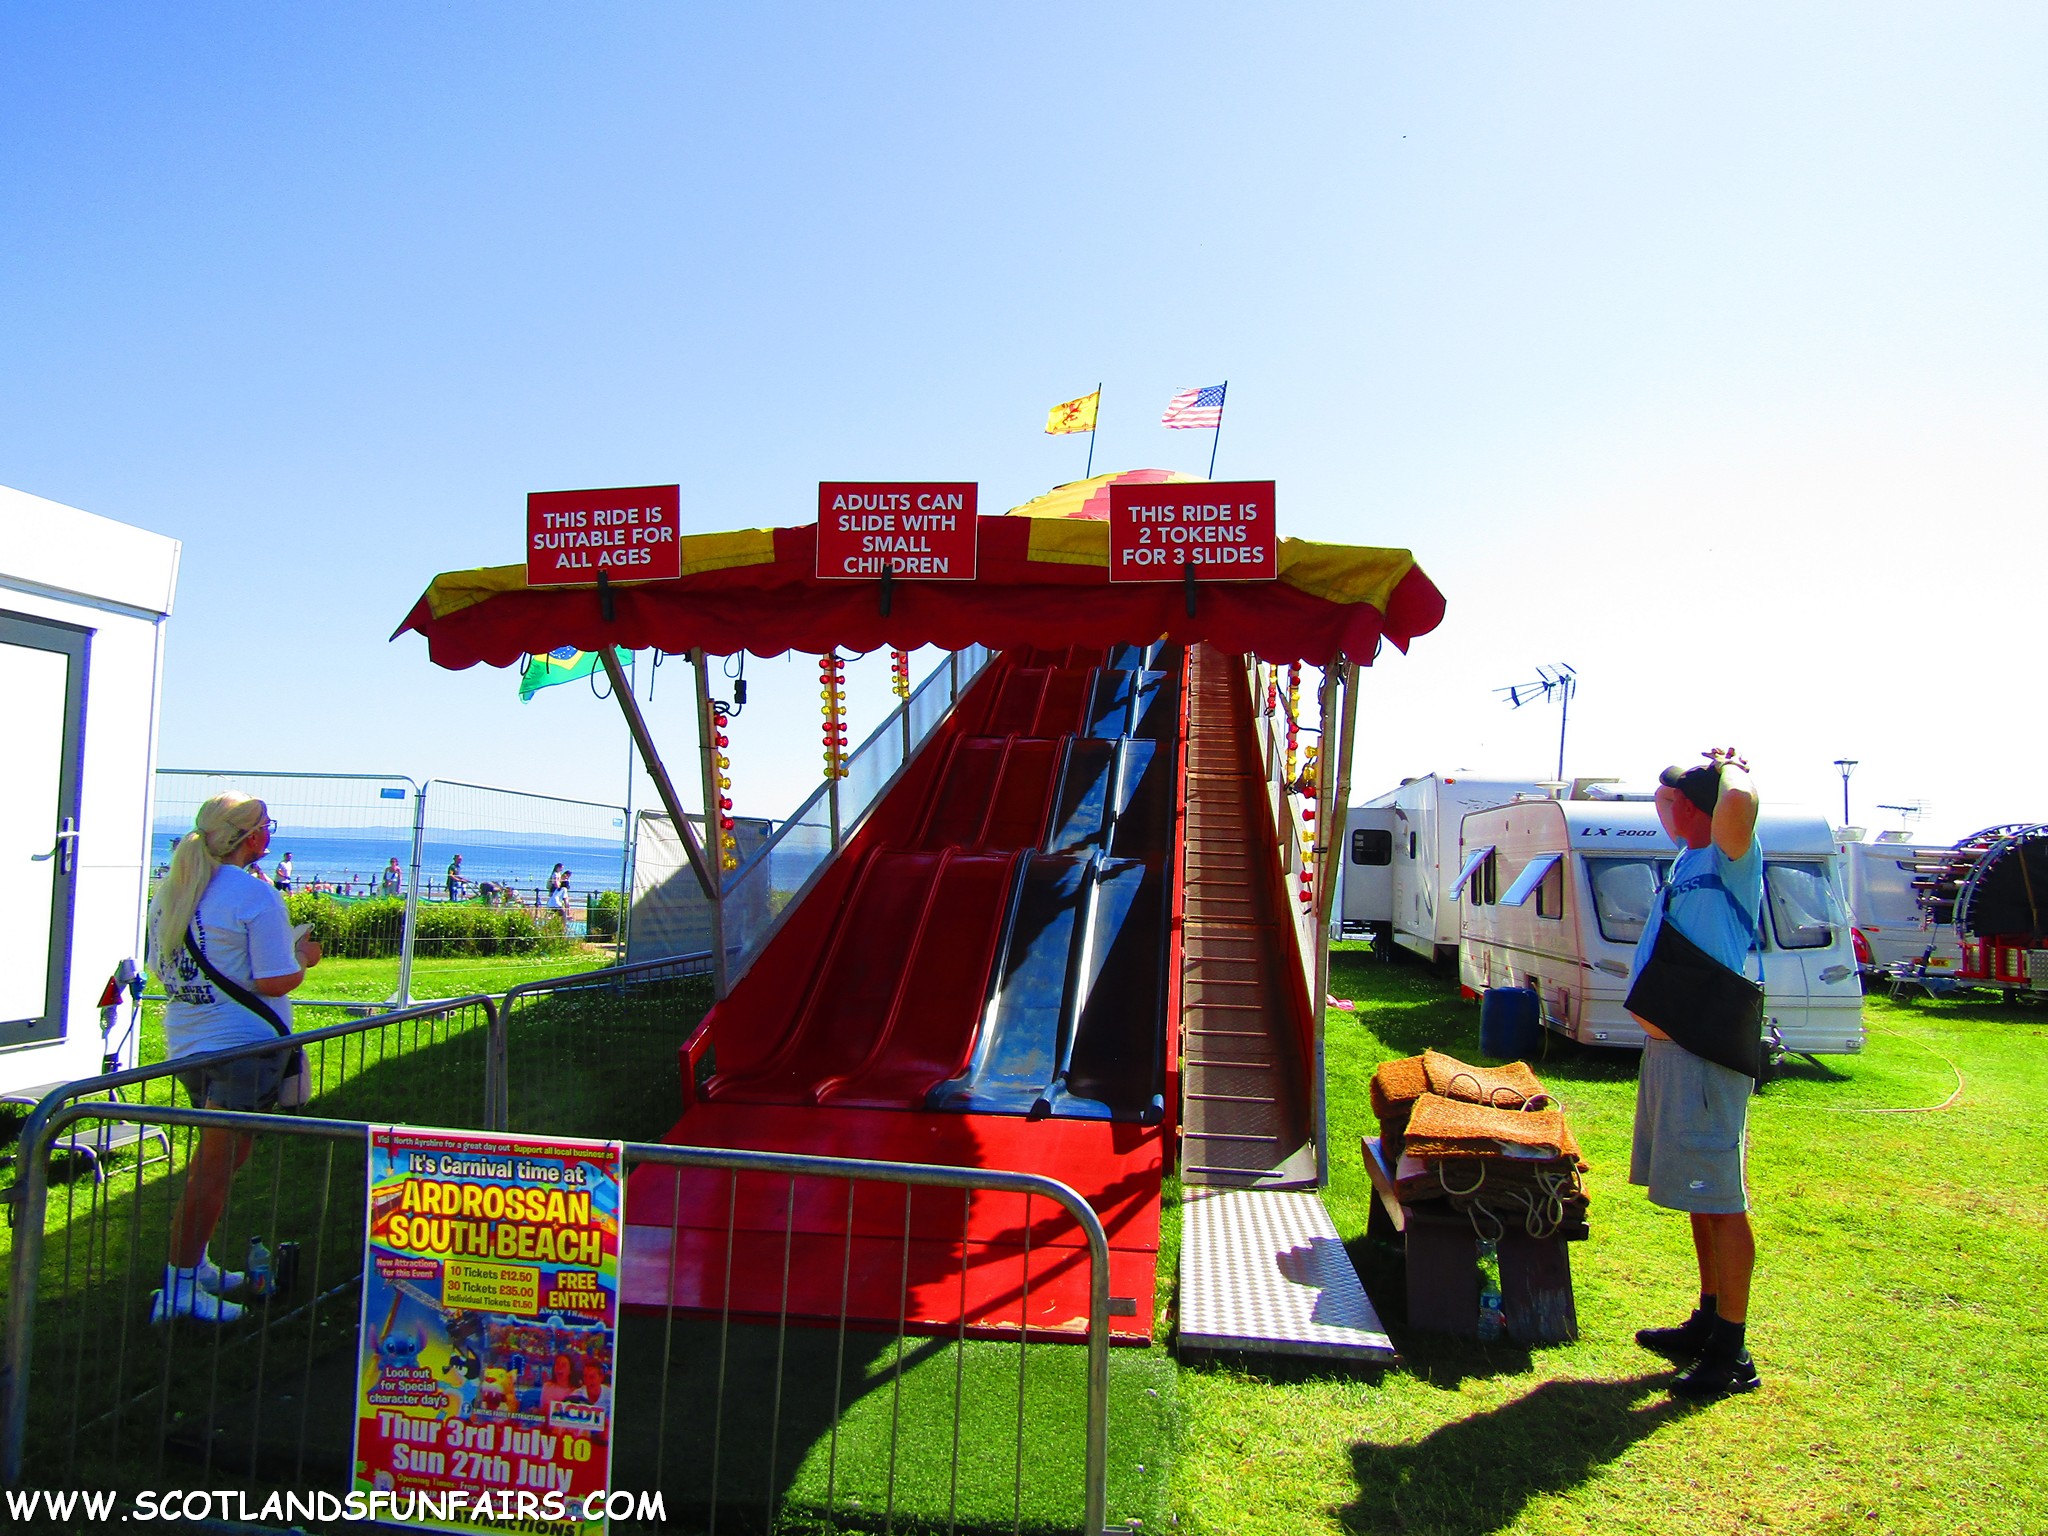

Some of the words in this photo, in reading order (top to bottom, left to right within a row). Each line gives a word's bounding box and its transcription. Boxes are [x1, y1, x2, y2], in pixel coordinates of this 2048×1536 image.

[832, 494, 911, 510] ADULTS
[917, 494, 963, 510] CAN
[543, 511, 587, 529] THIS
[594, 508, 639, 526] RIDE
[645, 507, 662, 523] IS
[1128, 505, 1175, 523] THIS
[1183, 504, 1232, 522] RIDE
[1239, 503, 1257, 521] IS
[838, 515, 895, 531] SLIDE
[902, 515, 956, 531] WITH
[534, 530, 625, 550] SUITABLE
[633, 527, 673, 544] FOR
[1139, 527, 1151, 544] 2
[1157, 525, 1247, 544] TOKENS
[862, 536, 931, 552] SMALL
[556, 552, 592, 569] ALL
[598, 548, 651, 567] AGES
[1123, 549, 1166, 565] FOR
[1173, 548, 1185, 565] 3
[1191, 546, 1264, 565] SLIDES
[1581, 827, 1611, 836] LX
[1616, 829, 1657, 837] 2000
[377, 1136, 391, 1144] Visi
[394, 1137, 414, 1145] North
[415, 1138, 443, 1148] Ayrshire
[445, 1140, 455, 1148] for
[463, 1142, 482, 1151] great
[483, 1142, 497, 1152] day
[498, 1143, 511, 1152] out
[514, 1144, 542, 1155] Support
[544, 1147, 553, 1155] all
[554, 1147, 572, 1156] local
[409, 1153, 435, 1173] It's
[440, 1156, 512, 1178] Carnival
[517, 1161, 560, 1181] time
[563, 1165, 585, 1184] at
[401, 1179, 590, 1226] ARDROSSAN
[387, 1215, 489, 1256] SOUTH
[496, 1224, 601, 1266] BEACH
[376, 1258, 393, 1267] New
[394, 1258, 438, 1269] Attractions
[383, 1268, 394, 1277] for
[396, 1268, 410, 1277] this
[412, 1269, 433, 1278] Event
[450, 1266, 461, 1276] 10
[464, 1266, 498, 1280] Tickets
[500, 1270, 532, 1283] £12.50
[557, 1272, 597, 1291] FREE
[448, 1280, 460, 1291] 30
[462, 1281, 497, 1295] Tickets
[499, 1285, 534, 1298] £35.00
[447, 1293, 482, 1305] Individual
[483, 1297, 511, 1308] Tickets
[512, 1300, 533, 1310] £1.50
[548, 1291, 606, 1309] ENTRY!
[386, 1367, 410, 1379] Look
[412, 1369, 430, 1379] out
[380, 1380, 396, 1391] for
[398, 1381, 436, 1394] Special
[369, 1393, 419, 1405] character
[421, 1393, 448, 1408] day's
[378, 1411, 442, 1443] Thur
[447, 1419, 495, 1450] 3rd
[500, 1425, 556, 1460] July
[563, 1435, 591, 1461] to
[393, 1443, 445, 1474] Sun
[451, 1449, 510, 1483] 27th
[517, 1458, 573, 1492] July
[397, 1473, 430, 1487] Opening
